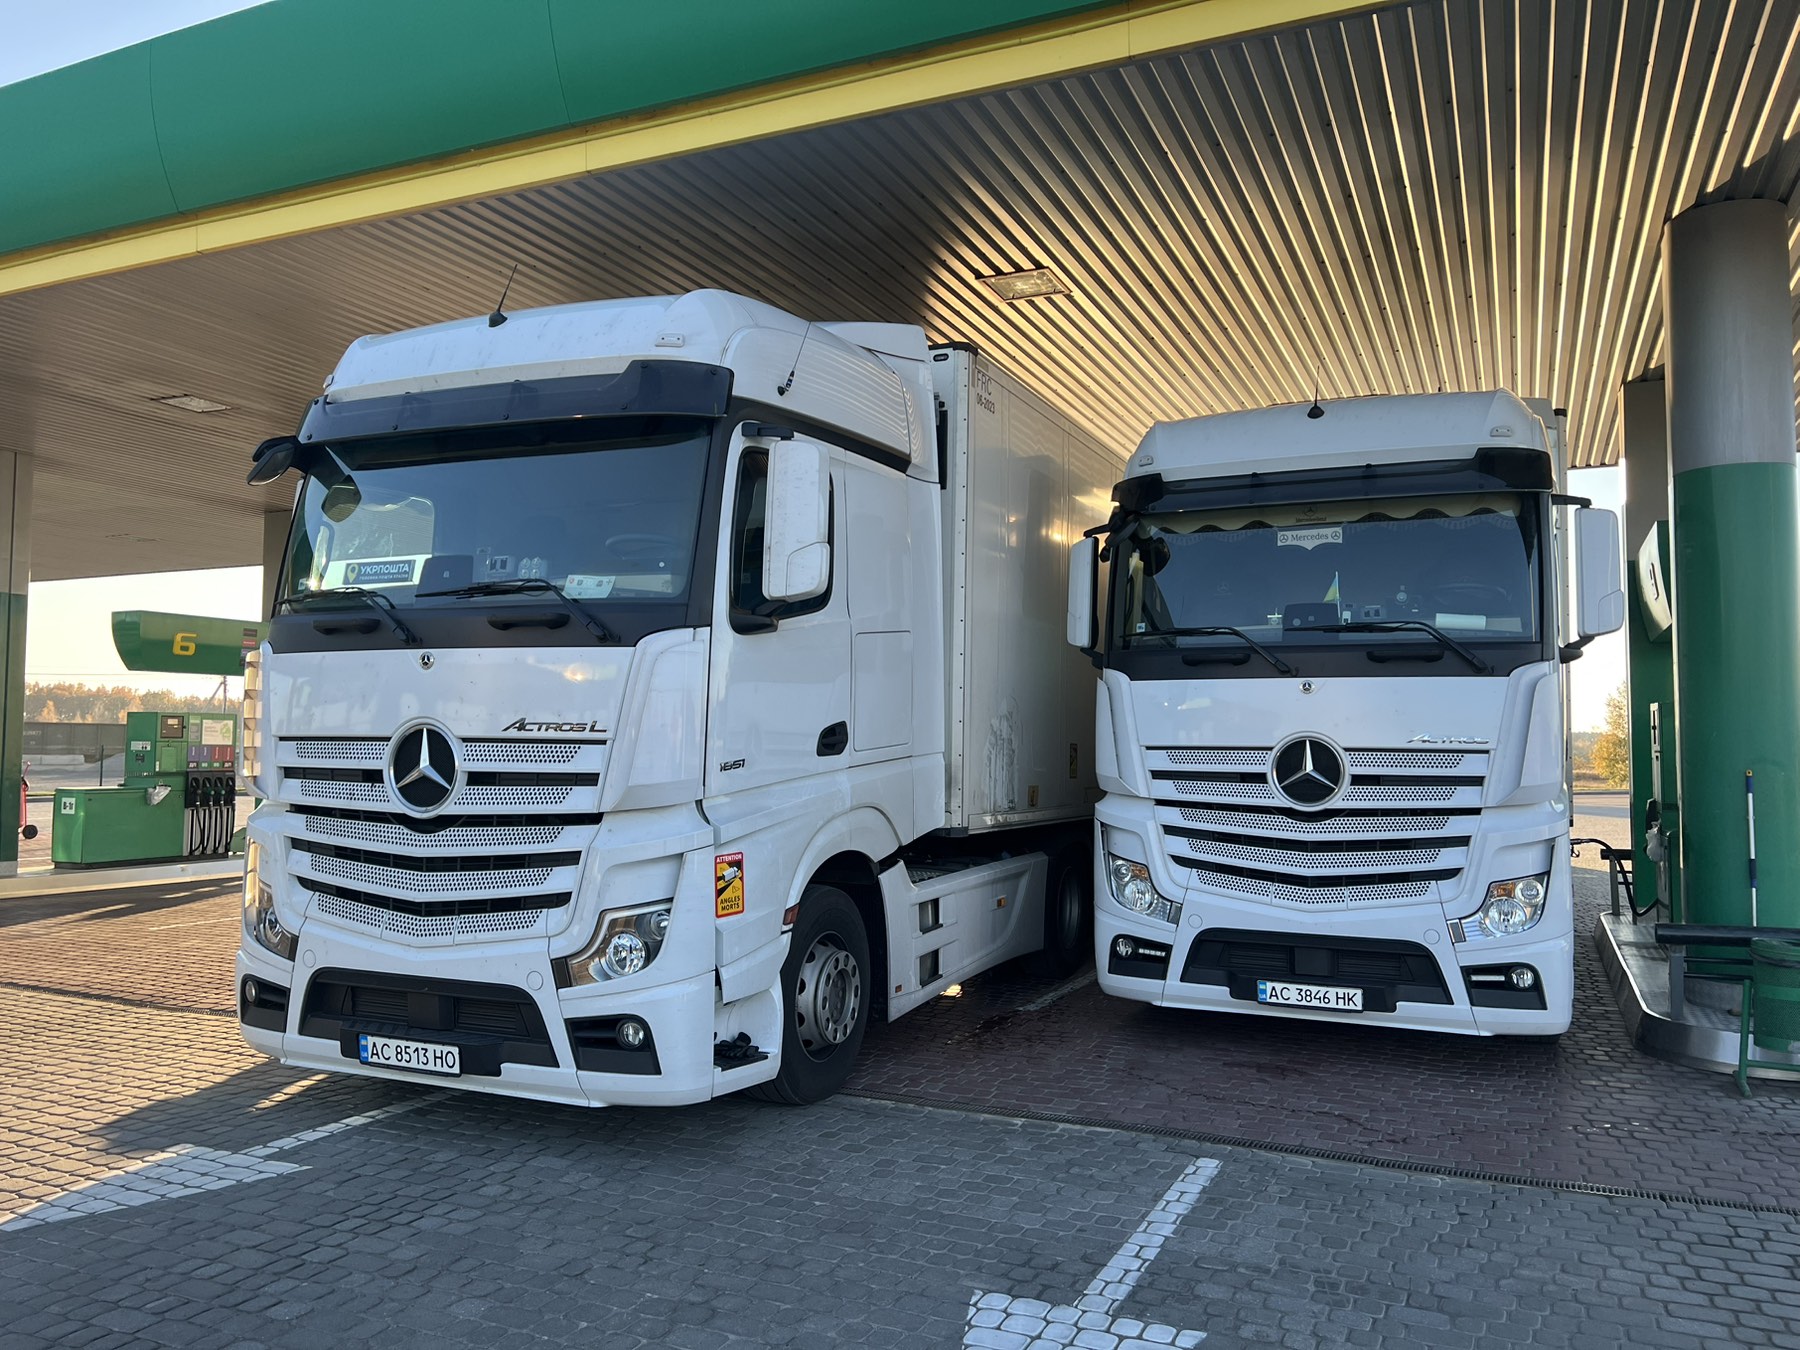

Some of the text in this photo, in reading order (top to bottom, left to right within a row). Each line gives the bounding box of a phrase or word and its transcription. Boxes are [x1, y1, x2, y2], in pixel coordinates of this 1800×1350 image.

[977, 371, 992, 396] FRC
[1291, 533, 1329, 542] Mercedes
[360, 563, 410, 575] УКРПОШТА
[173, 633, 198, 656] 6
[589, 720, 608, 733] L
[716, 853, 742, 863] ATTENTION
[719, 895, 741, 906] ANGLES
[720, 902, 740, 912] MORTS
[1268, 985, 1358, 1007] AC 3846 HK
[370, 1041, 456, 1069] AC 8513 HO
